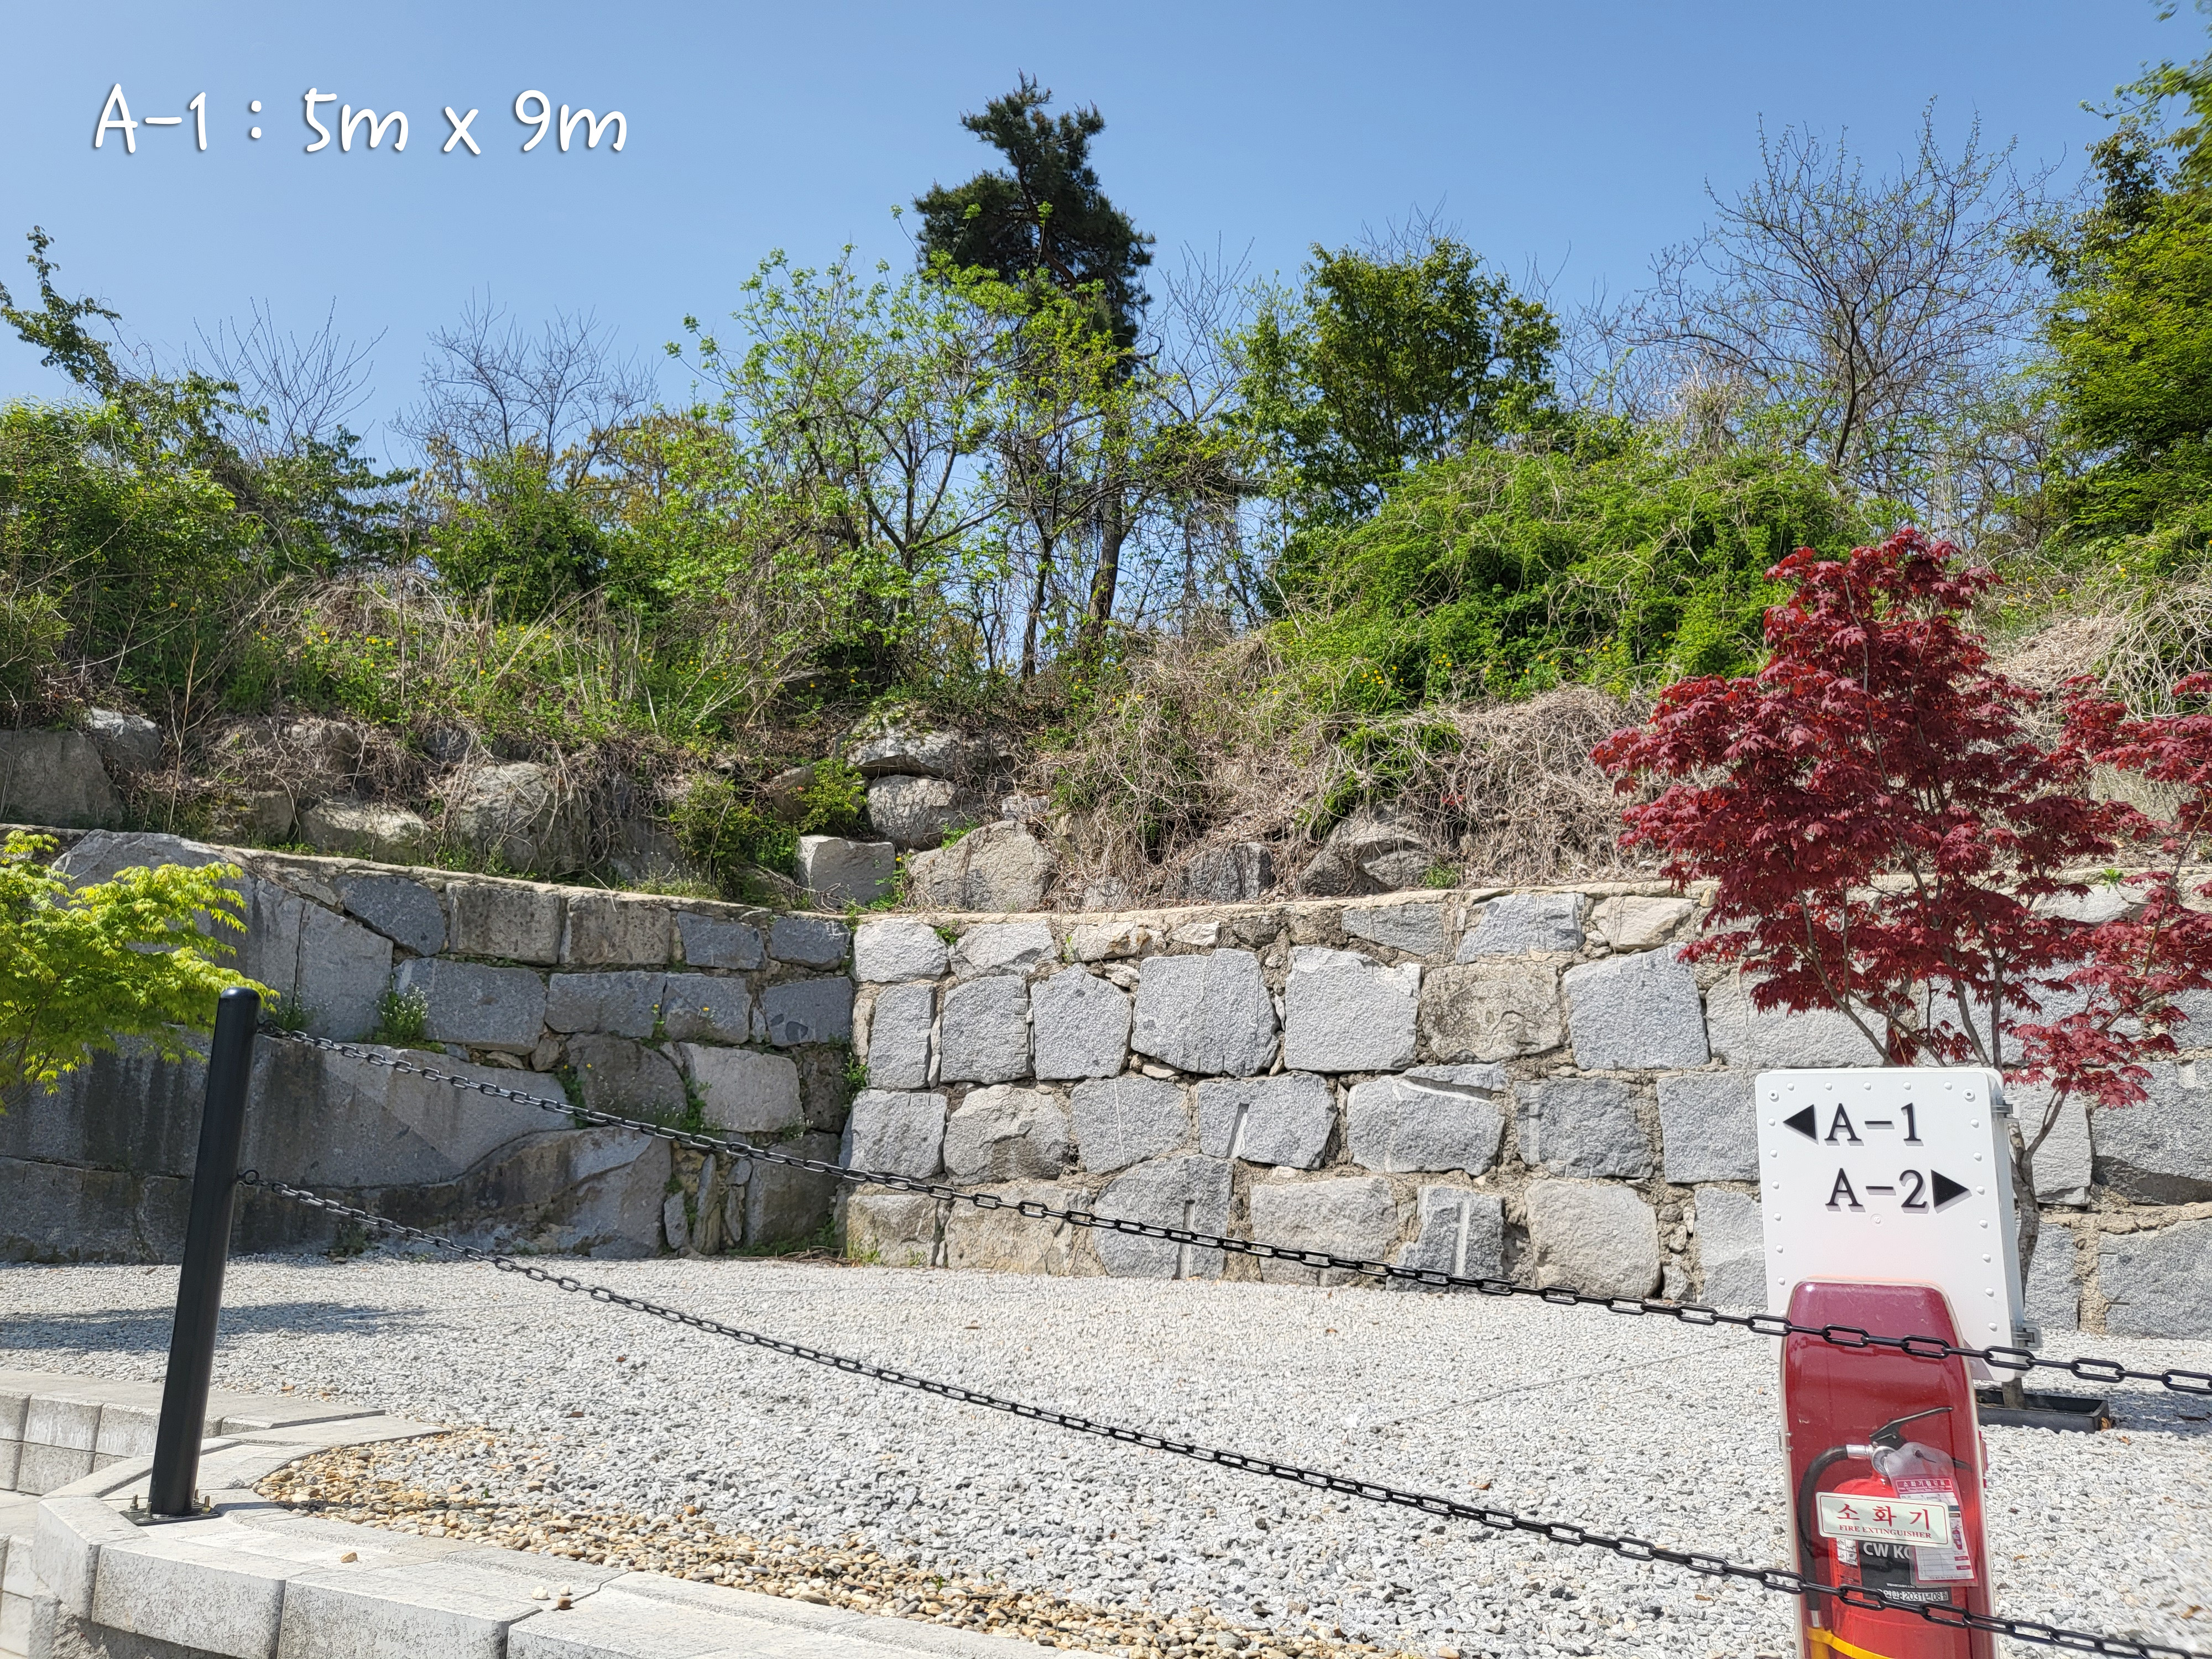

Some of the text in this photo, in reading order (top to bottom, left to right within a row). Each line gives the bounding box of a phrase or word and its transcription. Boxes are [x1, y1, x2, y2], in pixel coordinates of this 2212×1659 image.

[1824, 1102, 1924, 1145] A-1
[1825, 1167, 1929, 1212] A-2
[1839, 1524, 1932, 1539] FIRE EXTINGUISHER
[1863, 1542, 1889, 1558] CW
